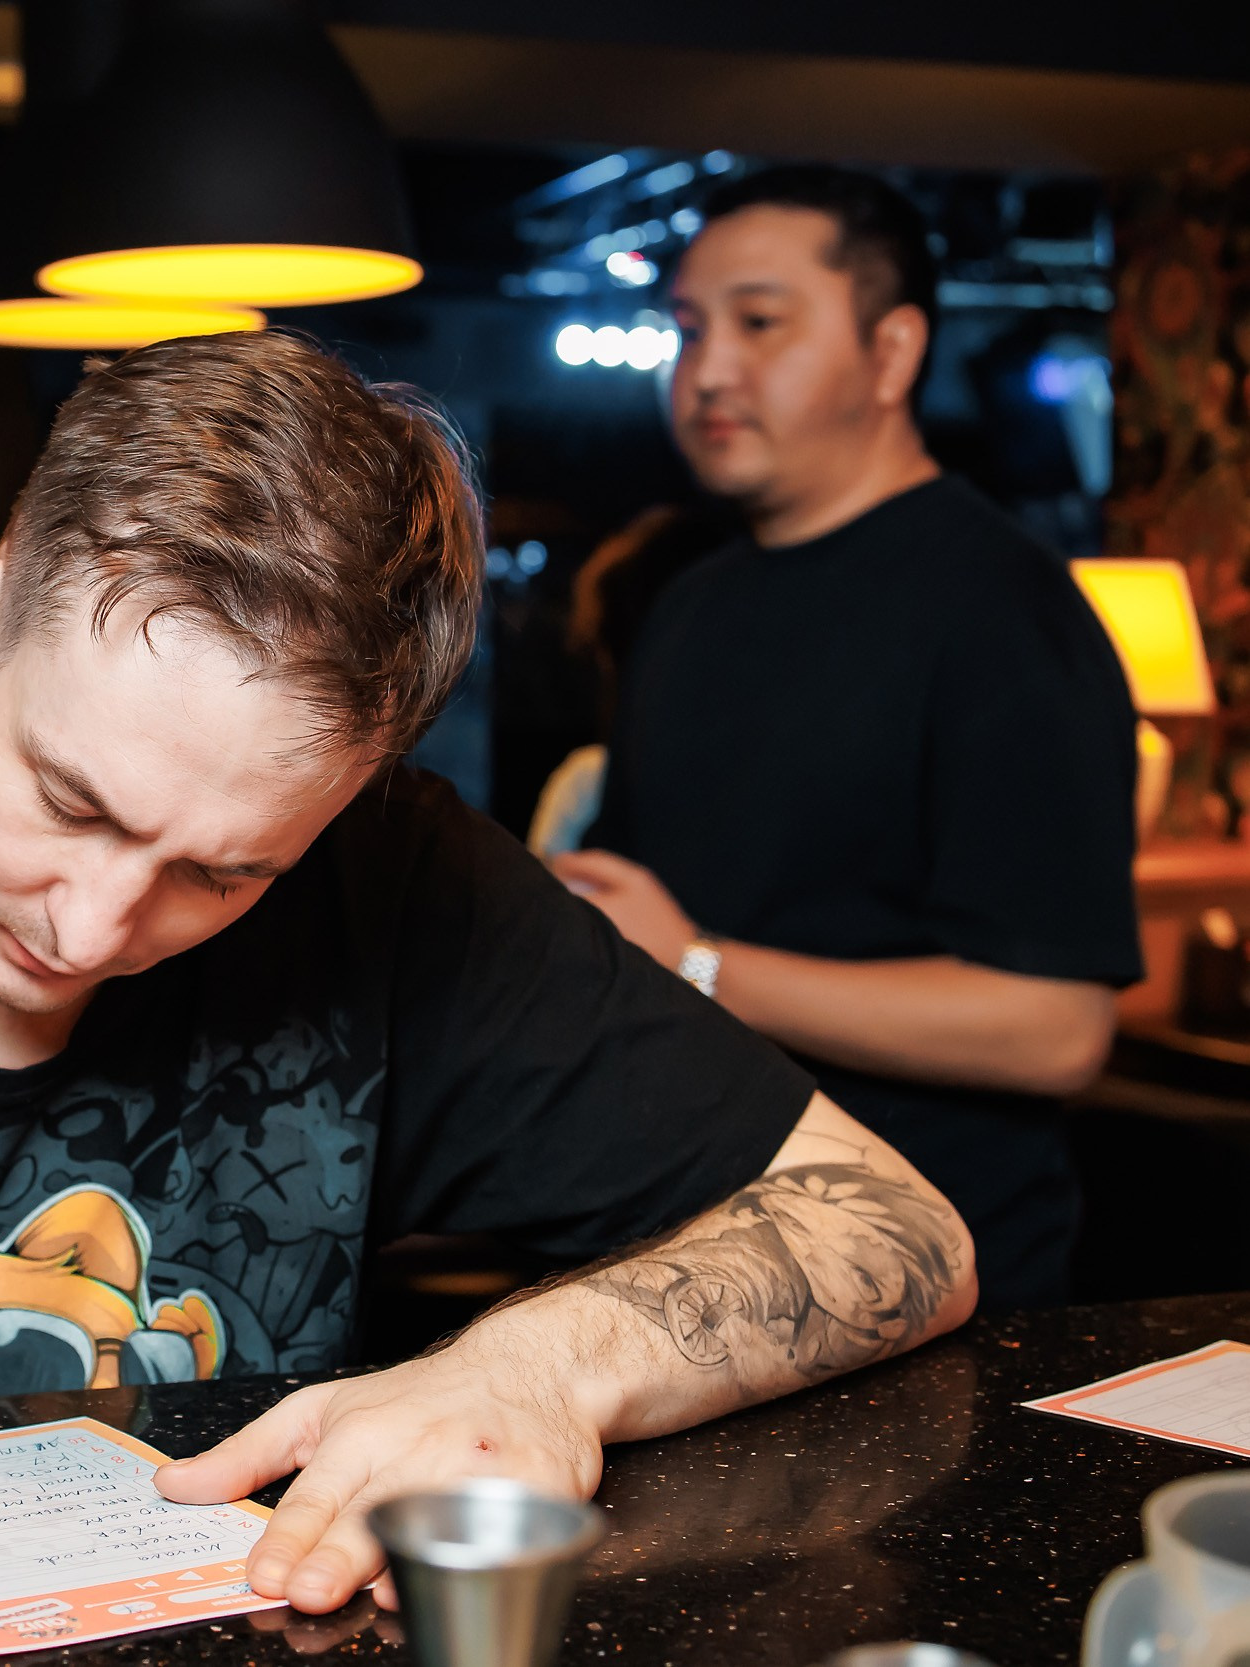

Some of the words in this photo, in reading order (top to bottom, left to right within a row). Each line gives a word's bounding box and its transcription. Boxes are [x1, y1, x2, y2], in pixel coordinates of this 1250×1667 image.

[111, 1455, 125, 1464] 8
[238, 1521, 253, 1529] 2
[11, 1616, 68, 1633] QUIZ
